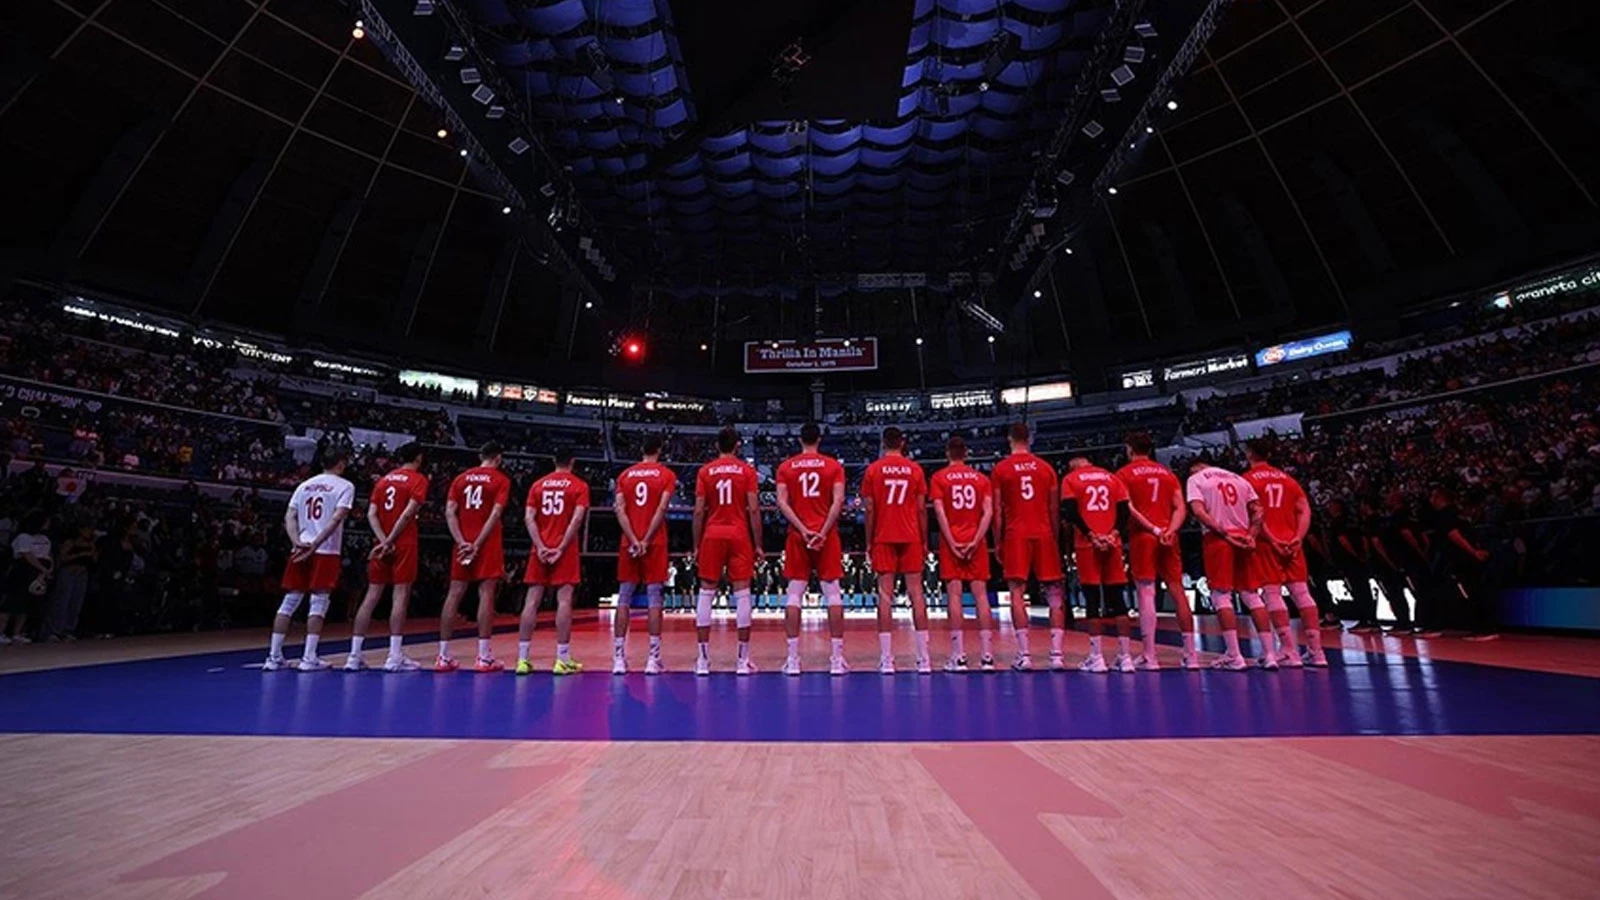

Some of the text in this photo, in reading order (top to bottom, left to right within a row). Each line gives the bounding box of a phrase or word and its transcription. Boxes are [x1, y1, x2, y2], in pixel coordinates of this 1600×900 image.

[463, 484, 484, 509] 14
[635, 481, 648, 506] 9
[715, 479, 732, 505] 11
[799, 472, 820, 497] 12
[884, 479, 909, 505] 77
[951, 484, 976, 510] 59
[1020, 475, 1035, 500] 5
[1147, 477, 1160, 503] 7
[1217, 481, 1239, 507] 19
[1264, 483, 1283, 508] 17
[304, 496, 323, 520] 16
[383, 486, 396, 510] 3
[541, 491, 565, 516] 55
[1085, 485, 1110, 511] 23
